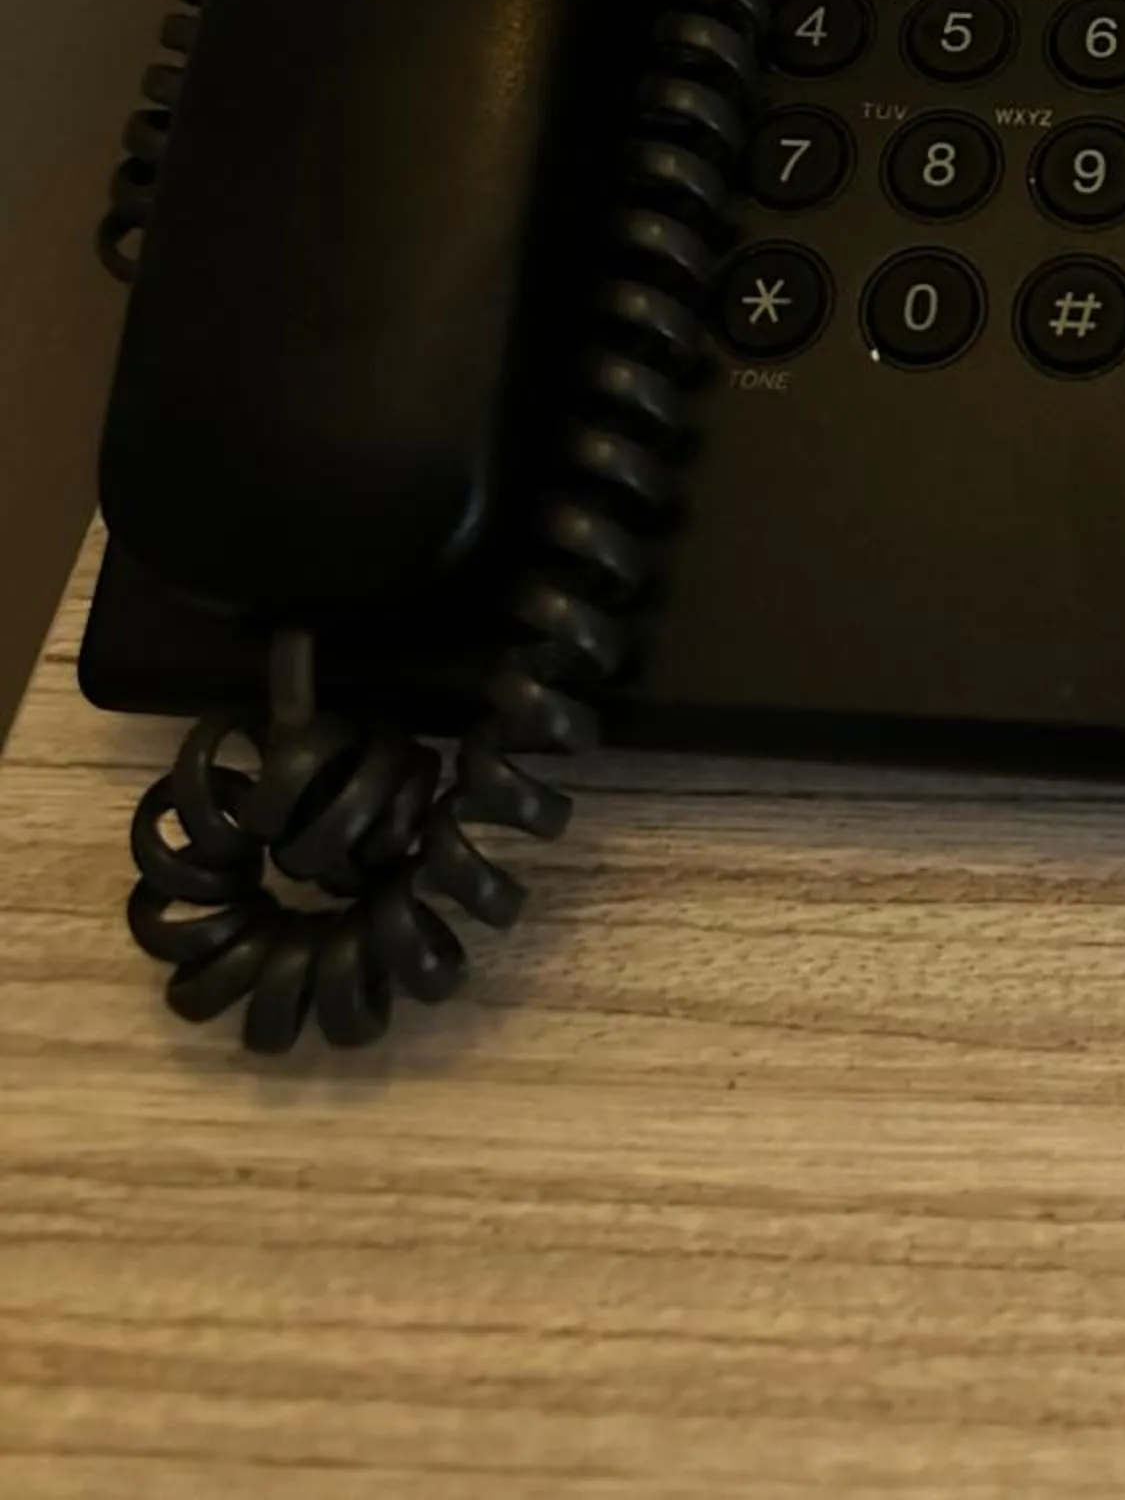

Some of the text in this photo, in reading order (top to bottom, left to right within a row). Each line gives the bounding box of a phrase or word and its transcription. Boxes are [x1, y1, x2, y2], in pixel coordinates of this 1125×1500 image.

[794, 6, 829, 48] 4
[940, 11, 974, 53] 5
[1085, 16, 1118, 60] 6
[862, 102, 909, 120] TUV
[995, 107, 1053, 129] WXYZ
[779, 138, 813, 183] 7
[922, 140, 957, 187] 8
[1072, 148, 1108, 195] 9
[903, 283, 939, 332] 0
[1048, 291, 1103, 338] #
